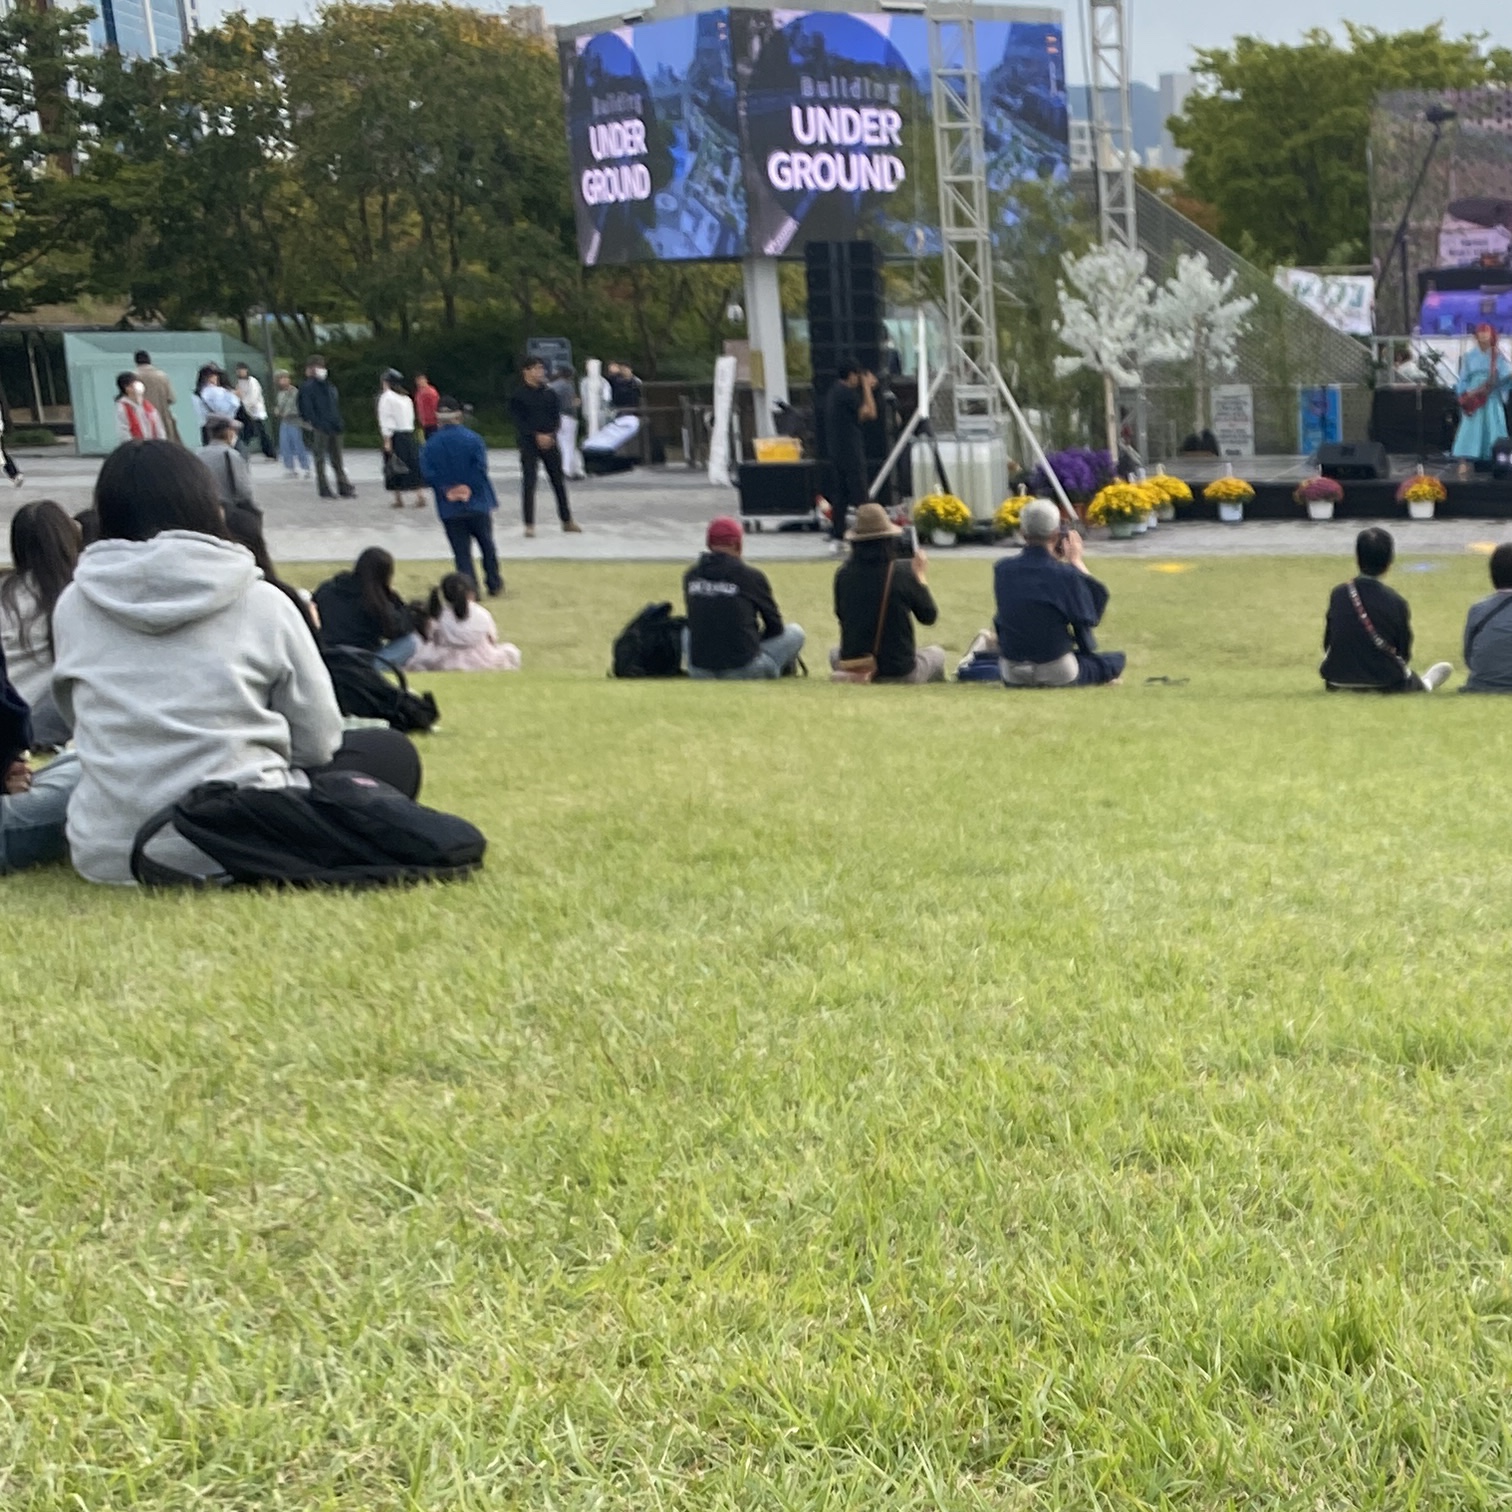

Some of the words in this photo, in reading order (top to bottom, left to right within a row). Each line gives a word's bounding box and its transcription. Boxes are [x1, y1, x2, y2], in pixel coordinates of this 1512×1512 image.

[589, 118, 648, 162] UNDER
[791, 104, 903, 147] UNDER
[582, 163, 651, 206] GROUND
[767, 151, 906, 192] GROUND
